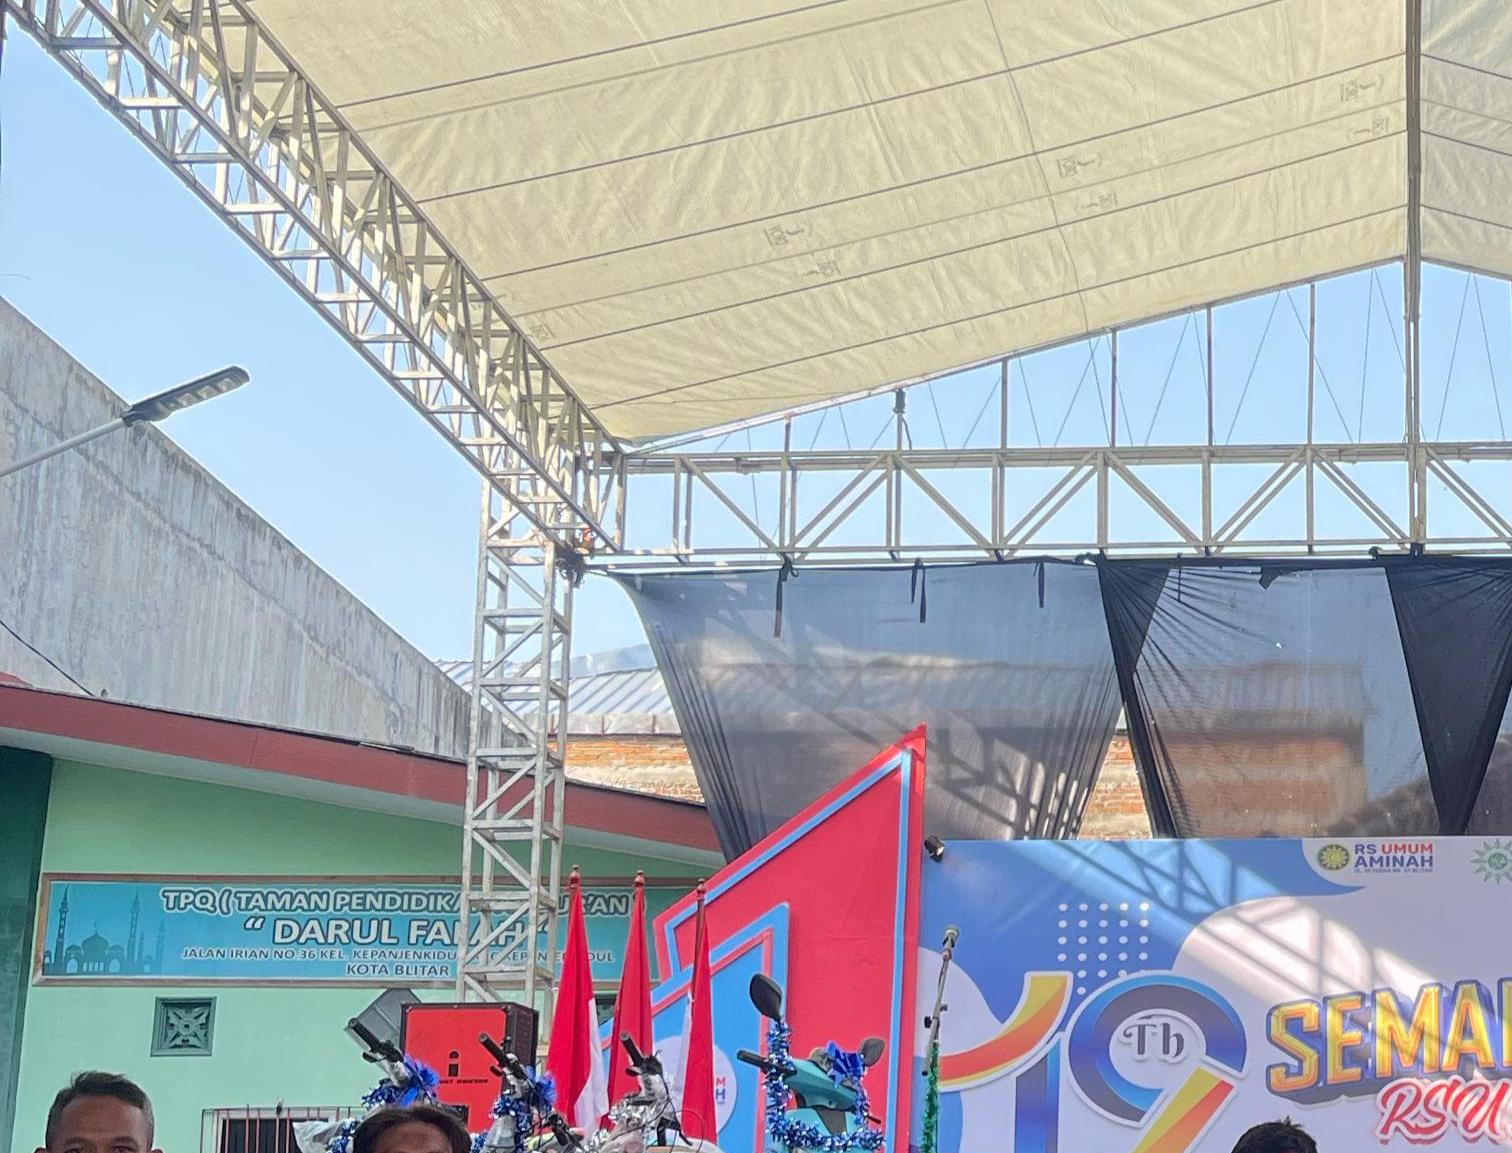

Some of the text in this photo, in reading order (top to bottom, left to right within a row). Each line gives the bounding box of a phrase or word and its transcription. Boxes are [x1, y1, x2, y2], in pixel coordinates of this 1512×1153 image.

[1354, 843, 1433, 855] RS UMUM
[1354, 855, 1433, 868] AMINAH
[162, 889, 216, 911] TPQ
[235, 890, 329, 912] TAMAN
[333, 891, 484, 914] PENDIDIKA
[272, 918, 526, 947] DARUL FAAH
[182, 948, 226, 959] JALAN
[230, 948, 269, 959] IRIAN
[353, 949, 462, 961] KEPANJENKIDU
[347, 963, 449, 976] KOTA BLITAR
[1122, 1014, 1186, 1061] Th
[1374, 1078, 1509, 1143] RSU
